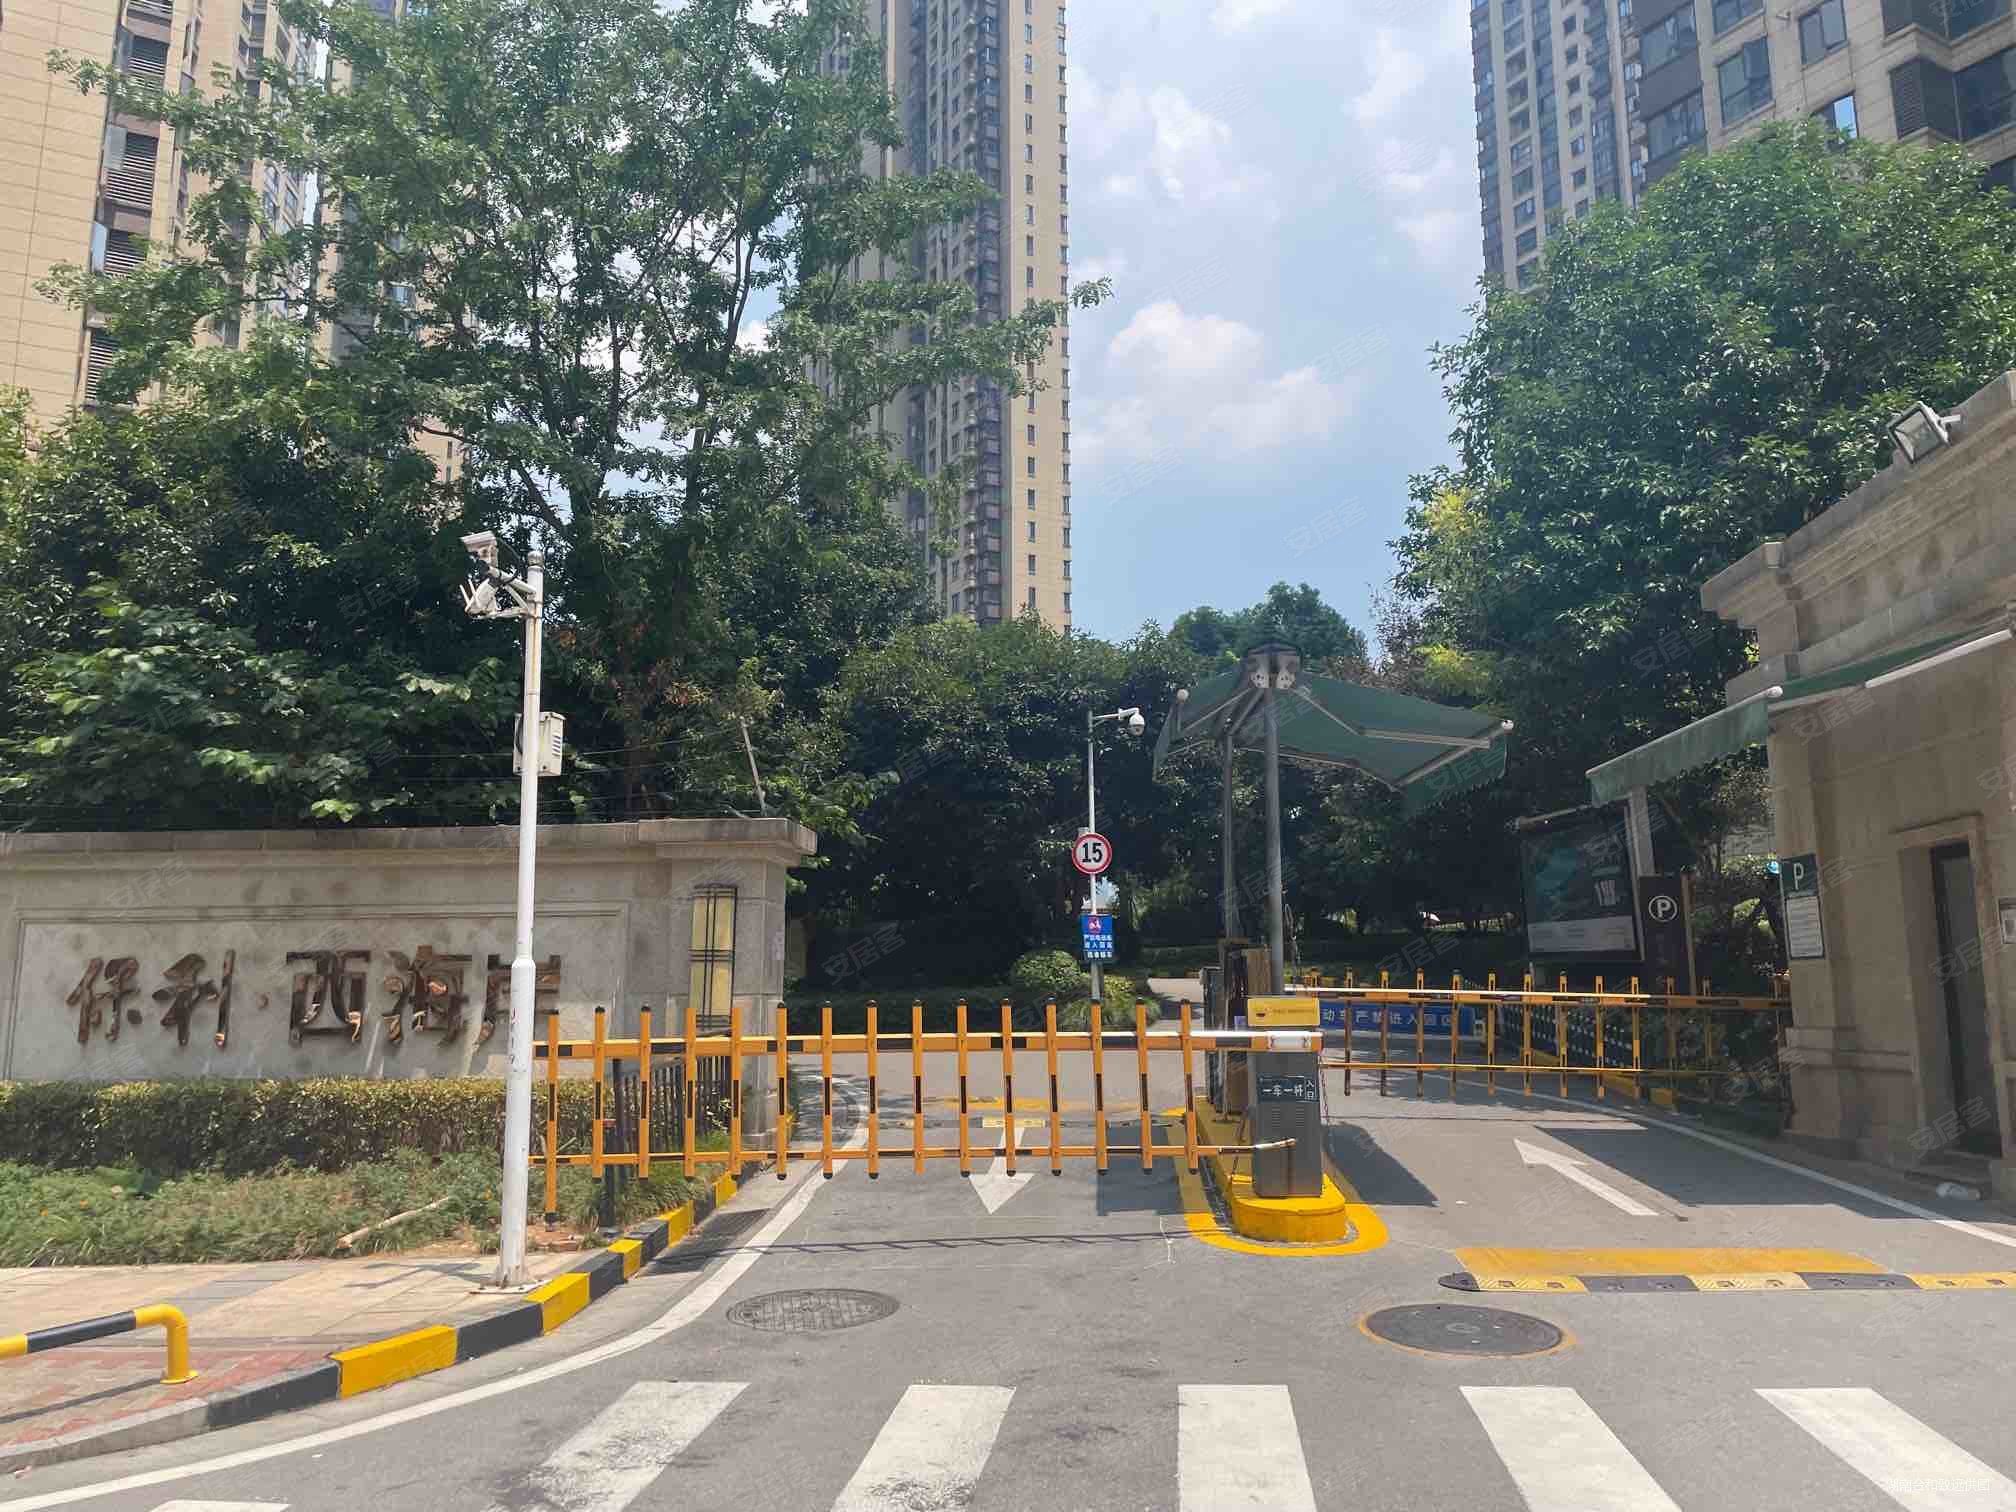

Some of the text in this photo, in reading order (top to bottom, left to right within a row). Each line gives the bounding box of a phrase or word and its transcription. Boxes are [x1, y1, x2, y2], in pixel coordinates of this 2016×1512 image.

[1081, 842, 1103, 863] 15
[1794, 862, 1804, 891] P
[1656, 899, 1671, 918] P
[66, 949, 562, 1046] 保利·西海岸
